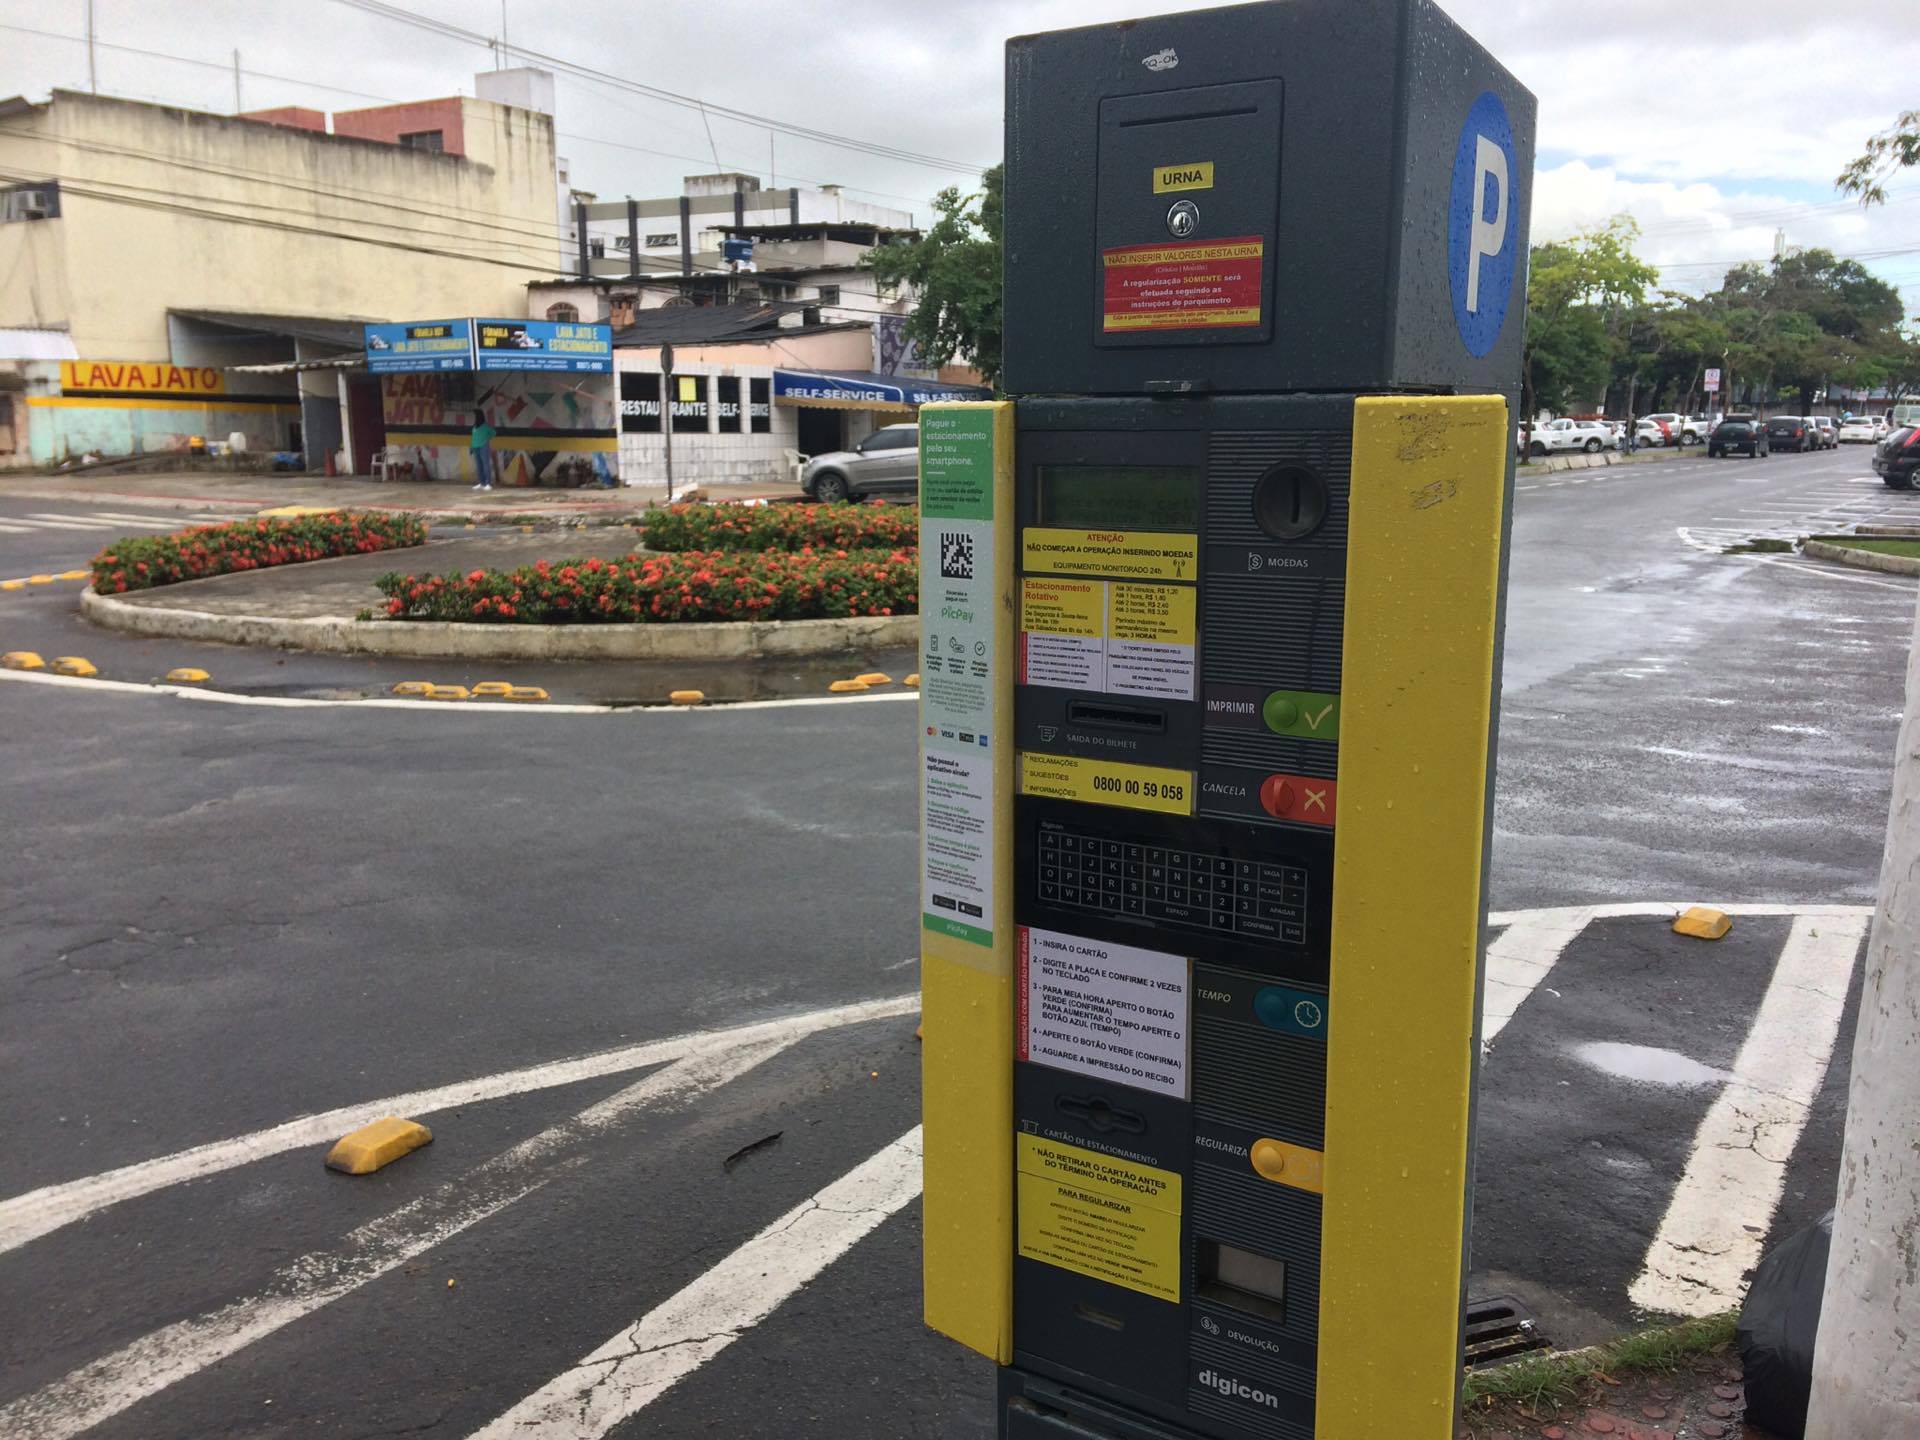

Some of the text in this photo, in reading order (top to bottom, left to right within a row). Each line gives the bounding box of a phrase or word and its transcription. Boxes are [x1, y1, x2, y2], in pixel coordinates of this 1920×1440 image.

[1163, 171, 1203, 185] URNA
[1466, 134, 1509, 313] P
[1109, 246, 1259, 264] NÃO INSERIR VALORES NESTA URNA
[1130, 278, 1181, 288] regularização
[1184, 275, 1222, 284] SOMENTE
[1175, 286, 1210, 296] seguindo
[785, 386, 885, 402] SELF-SERVICE
[926, 431, 987, 440] estacionamento
[926, 443, 957, 454] pelo seu
[1087, 533, 1124, 544] ATENÇÃO
[1026, 543, 1041, 552] NÃO
[1042, 544, 1076, 553] COMEÇAR
[1083, 546, 1121, 555] OPERAÇÃO
[1122, 548, 1161, 556] INSERINDO
[1162, 550, 1193, 558] MOEDAS
[1053, 561, 1162, 575] EQUIPAMENTO MONITORADO 24h
[1268, 558, 1309, 568] MOEDAS
[1025, 580, 1091, 592] Estacionamento
[1025, 592, 1059, 601] Rotativo
[941, 607, 974, 623] PicPay
[1136, 632, 1156, 640] HORAS
[1207, 700, 1255, 714] IMPRIMIR
[941, 729, 955, 738] VISA
[1092, 737, 1105, 745] DO
[1106, 739, 1137, 750] BILHETE
[927, 755, 937, 763] Não
[1030, 756, 1079, 768] RECLAMAÇÕES
[1030, 770, 1069, 781] SUGESTÕES
[1030, 784, 1077, 797] INFORMAÇÕES
[1094, 775, 1183, 801] 0800 00 59 058
[1202, 782, 1246, 797] CANCELA
[1042, 940, 1068, 952] INSIRA
[1069, 945, 1075, 953] O
[1076, 946, 1108, 959] CARTÃO
[1042, 957, 1067, 970] DIGITE
[1075, 964, 1101, 976] PLACA
[1108, 971, 1149, 986] CONFIRME
[1156, 981, 1182, 993] VEZES
[1042, 967, 1090, 983] NO TECLADO
[1042, 984, 1063, 996] PARA
[1064, 989, 1082, 1001] MEIA
[1083, 993, 1105, 1005] HORA
[1106, 998, 1137, 1012] APERTO
[1138, 1005, 1145, 1013] O
[1146, 1006, 1175, 1019] BOTÃO
[1197, 988, 1231, 1003] TEMPO
[1042, 993, 1113, 1017] VERDE (CONFIRMA)
[1042, 1002, 1180, 1040] PARA AUMENTAR O TEMPO APERTE O
[1042, 1011, 1122, 1037] BOTÃO AZUL (TEMPO)
[1042, 1029, 1071, 1042] APERTE
[1072, 1036, 1079, 1044] O
[1080, 1038, 1107, 1050] BOTÃO
[1108, 1044, 1134, 1057] VERDE
[1135, 1050, 1182, 1070] (CONFIRMA)
[1042, 1047, 1078, 1061] AGUARDE
[1079, 1056, 1085, 1064] A
[1086, 1057, 1131, 1074] IMPRESSÃO
[1132, 1068, 1144, 1077] DO
[1145, 1071, 1175, 1085] RECIBO
[1044, 1129, 1158, 1166] CARTÃO DE ESTACIONAMENTO
[1194, 1135, 1248, 1158] REGULARIZA
[1038, 1147, 1167, 1190] NÃO RETIRAR O CARTÃO ANTES
[1045, 1159, 1158, 1196] DO TÉRMINO DA OPERAÇÃO
[1058, 1187, 1132, 1214] PARA REGULARIZAR
[1228, 1330, 1280, 1353] DEVOLUÇÃO
[1198, 1370, 1279, 1409] digicon
